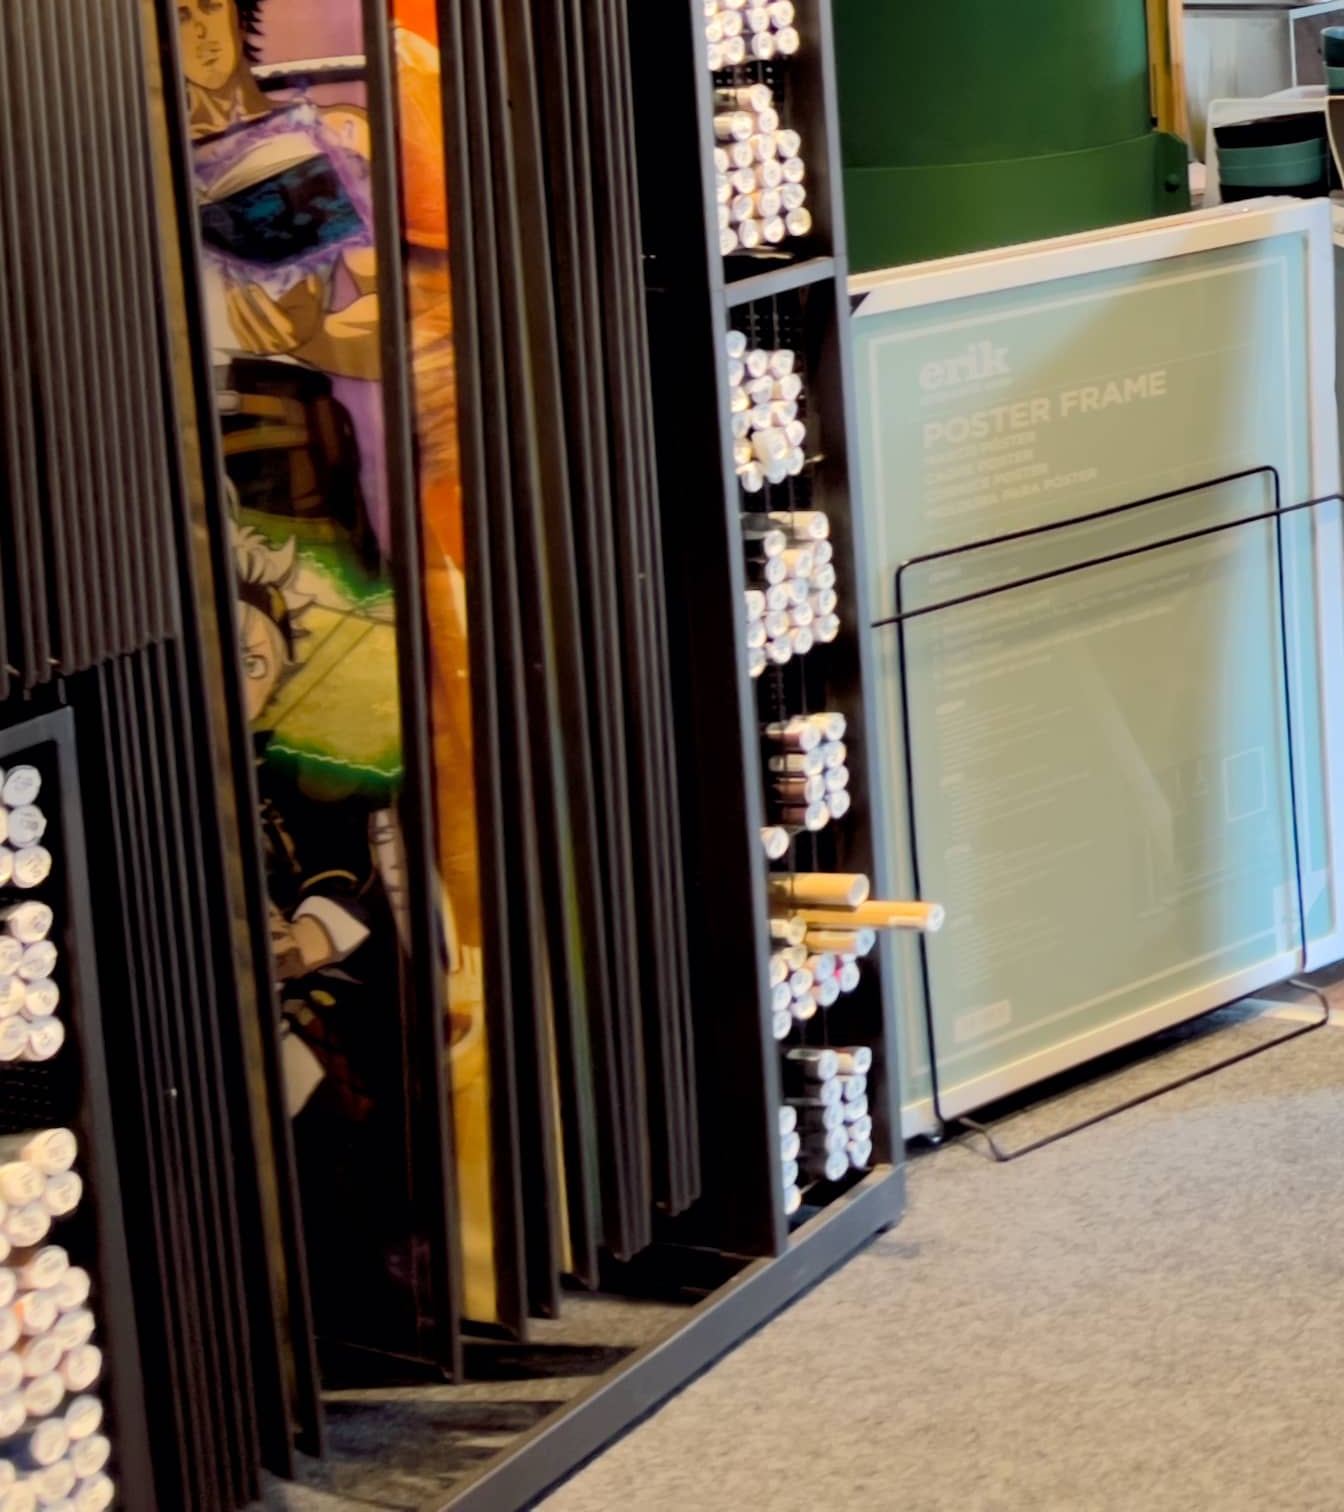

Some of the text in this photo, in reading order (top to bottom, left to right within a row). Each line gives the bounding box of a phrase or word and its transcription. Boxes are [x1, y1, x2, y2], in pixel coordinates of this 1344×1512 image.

[920, 340, 1010, 390] erik
[923, 399, 1051, 448] POSTER
[1060, 370, 1167, 417] FRAME
